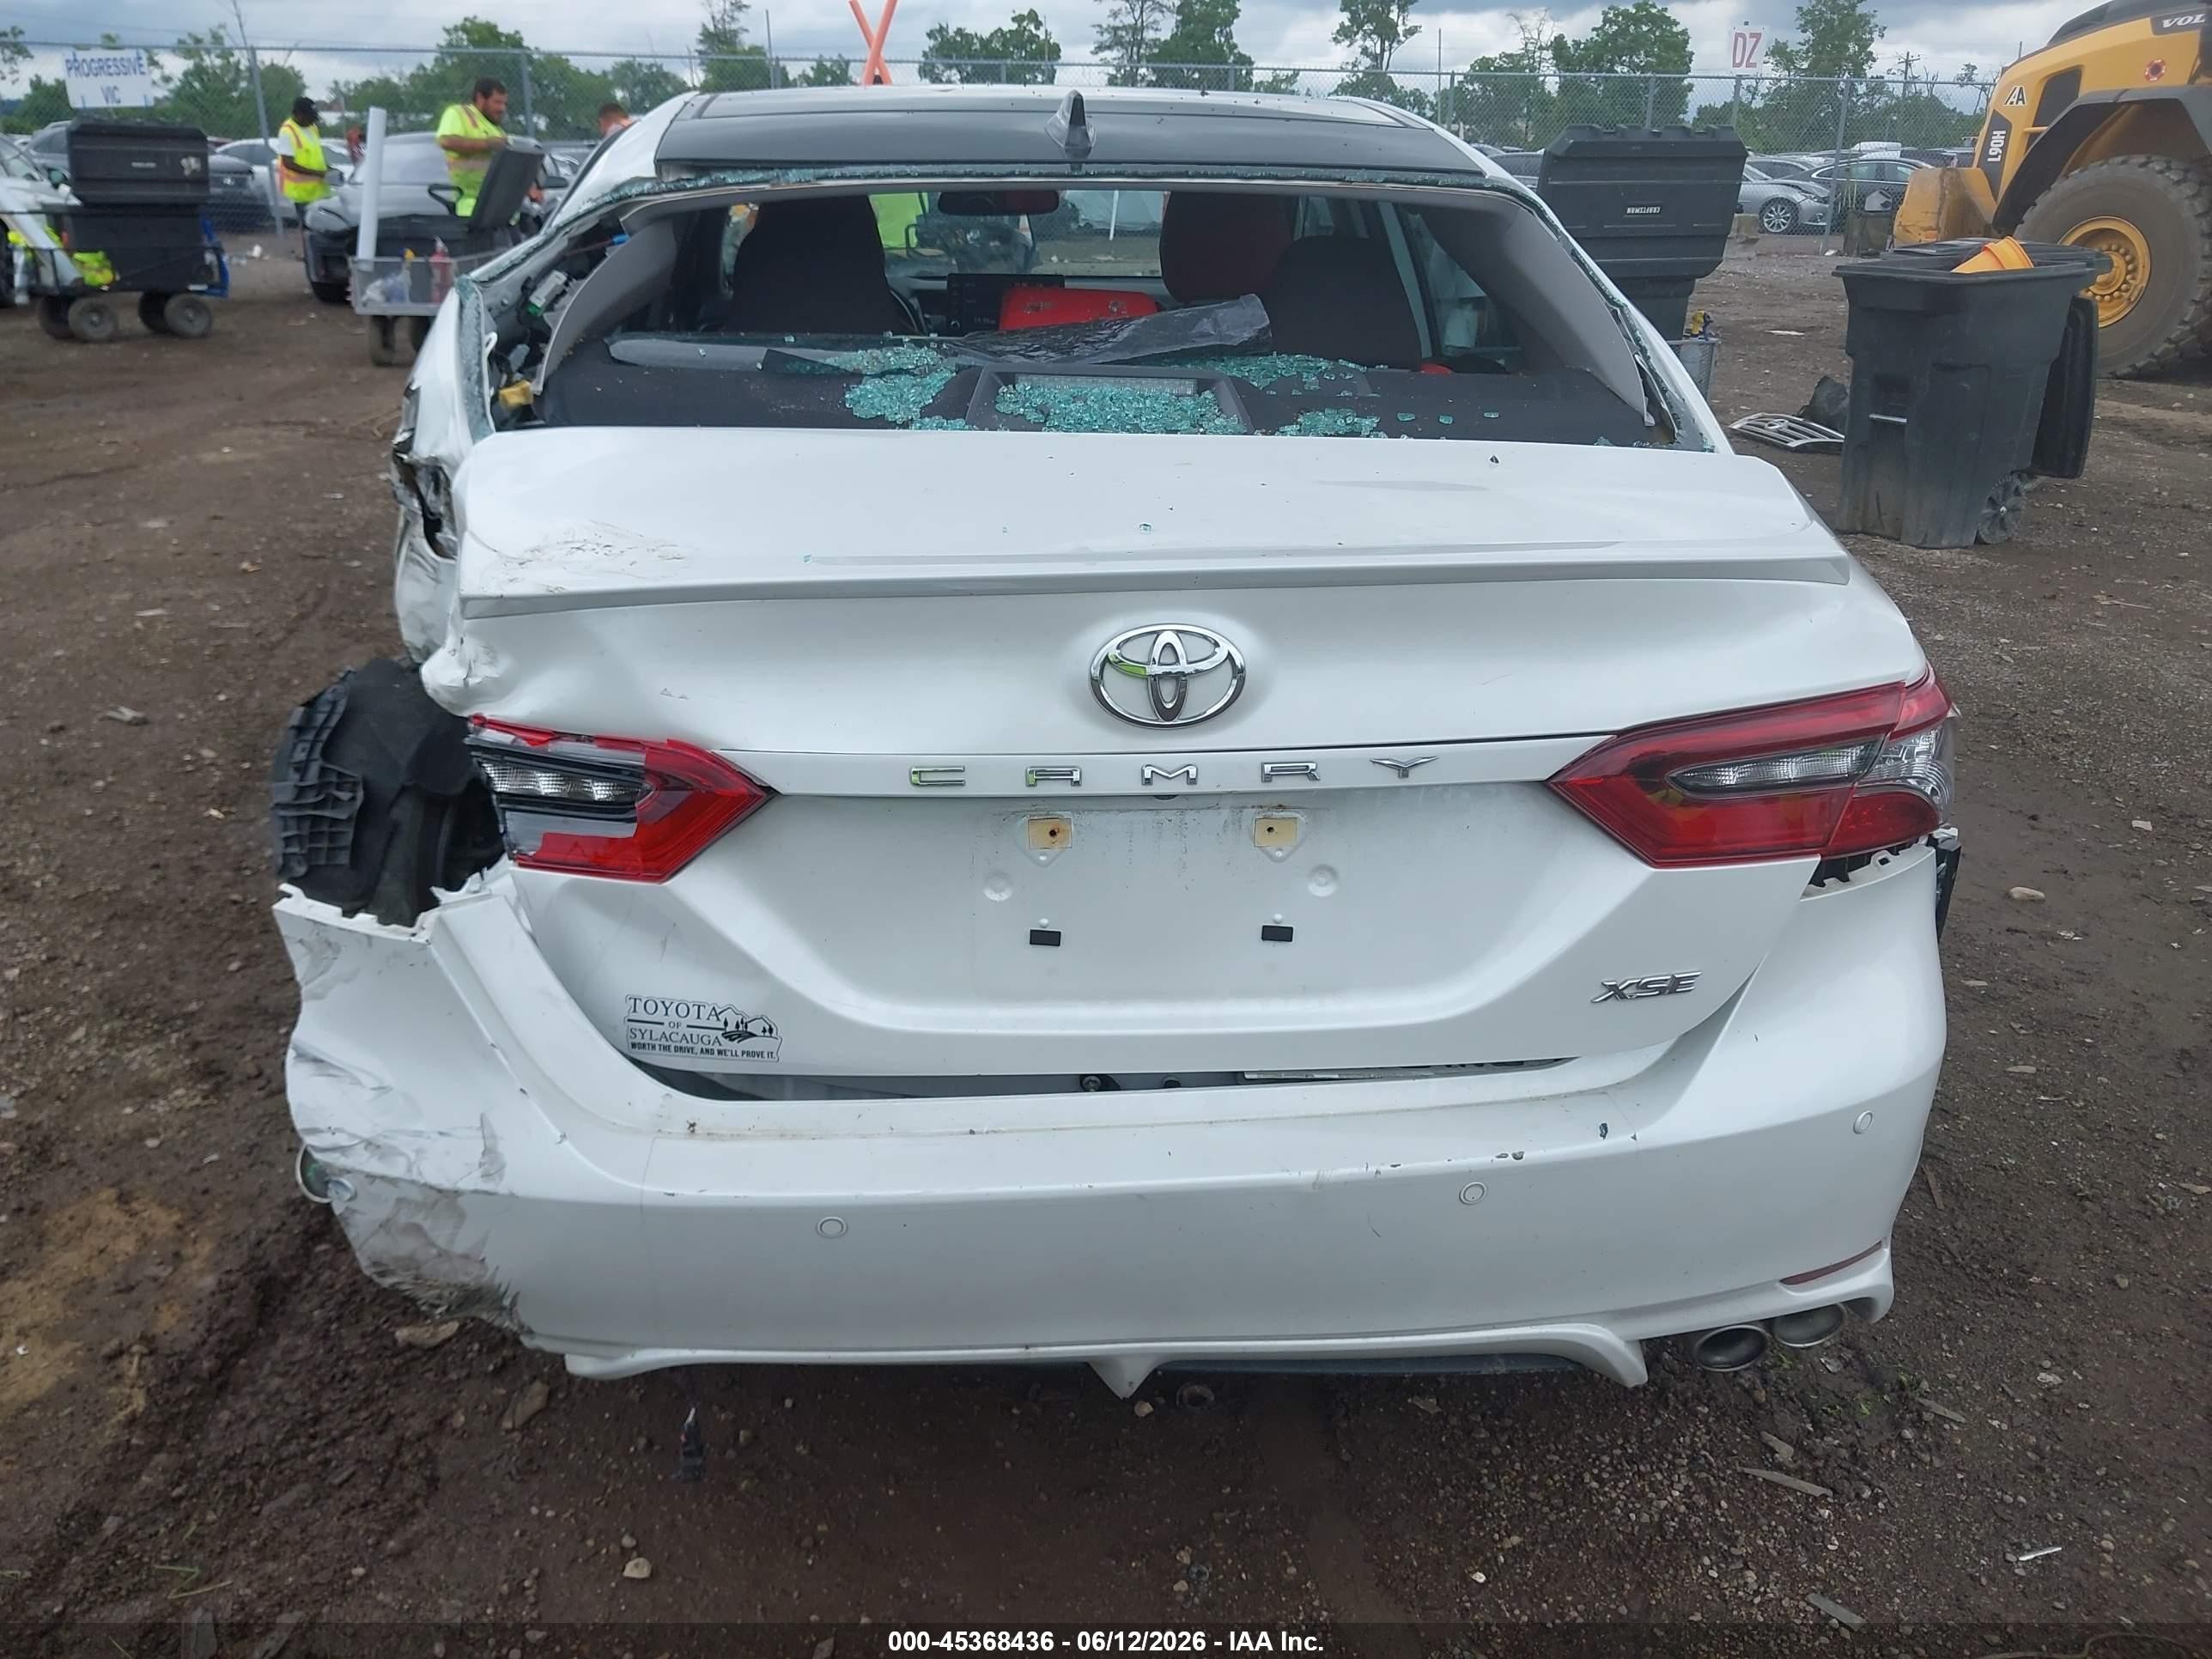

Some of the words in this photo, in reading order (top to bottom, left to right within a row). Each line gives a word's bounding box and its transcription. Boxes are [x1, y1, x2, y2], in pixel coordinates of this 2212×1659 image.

[1732, 32, 1762, 68] DZ
[65, 56, 146, 77] PROGRESSIVE
[100, 85, 121, 104] VIC
[1987, 131, 2006, 162] L90H
[910, 756, 1439, 787] CAMRY
[1590, 970, 1702, 1003] XSE
[629, 997, 720, 1022] TOYOTA
[629, 1028, 722, 1046] SYLACAUGA
[630, 1042, 656, 1051] WORTH
[658, 1043, 672, 1053] THE
[674, 1045, 697, 1055] DRIVE,
[700, 1047, 714, 1055] AND
[717, 1048, 739, 1057] WE'LL
[741, 1050, 765, 1059] PROVE
[767, 1050, 775, 1059] IT.
